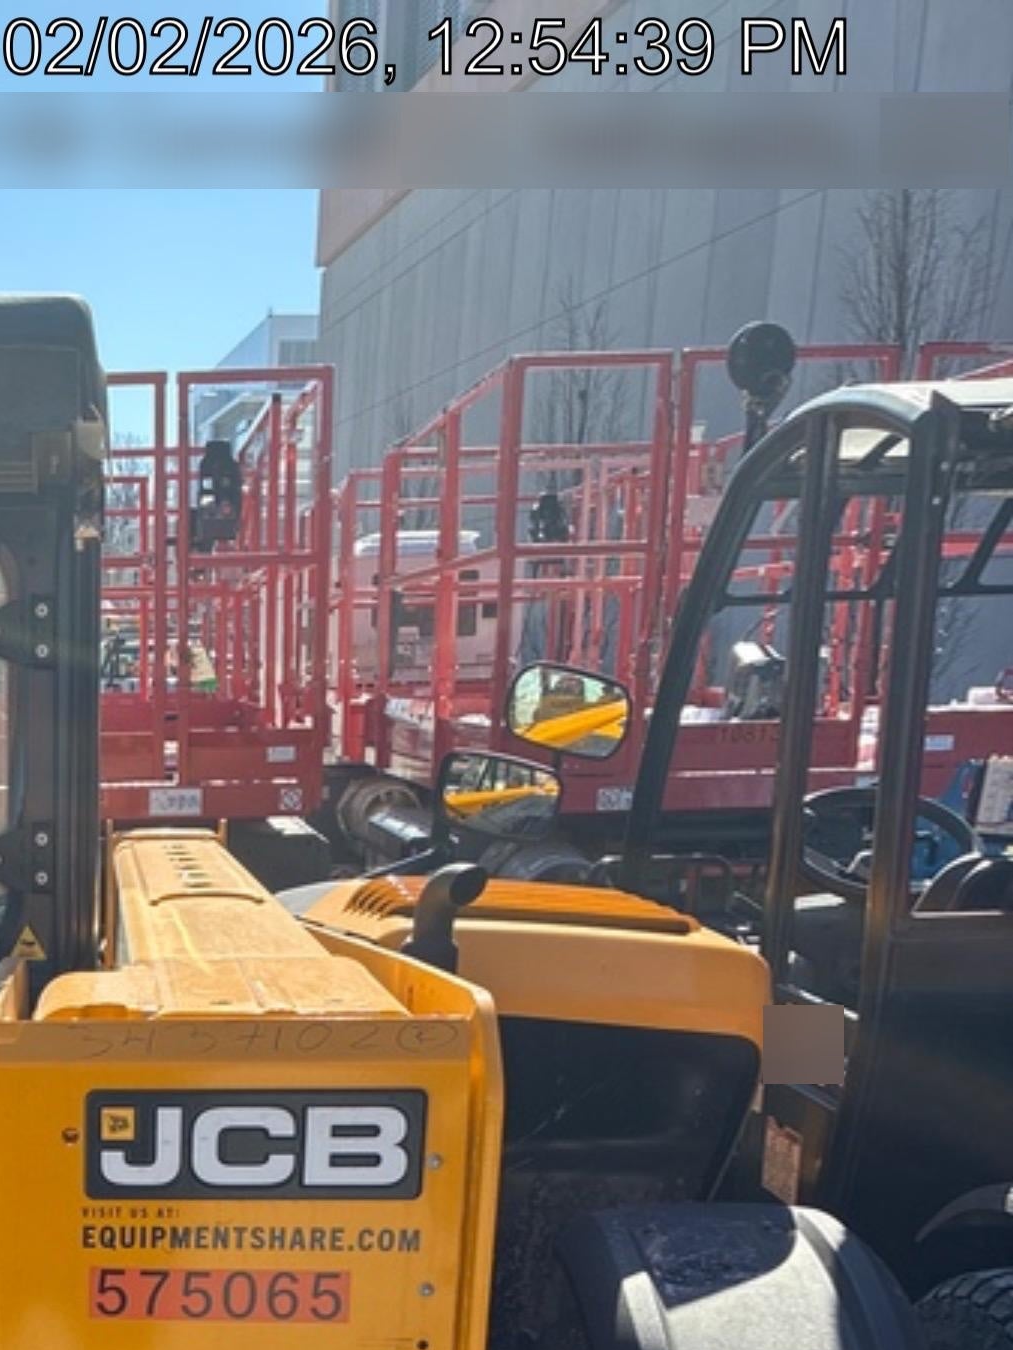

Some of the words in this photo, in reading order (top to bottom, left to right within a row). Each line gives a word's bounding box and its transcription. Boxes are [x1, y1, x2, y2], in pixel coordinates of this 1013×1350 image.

[99, 1105, 409, 1187] JCB
[82, 1207, 122, 1219] VISIT
[130, 1207, 149, 1219] US
[156, 1207, 182, 1219] AT:
[82, 1225, 421, 1252] EQUIPMENTSHARE.COM
[95, 1269, 343, 1320] 575065
